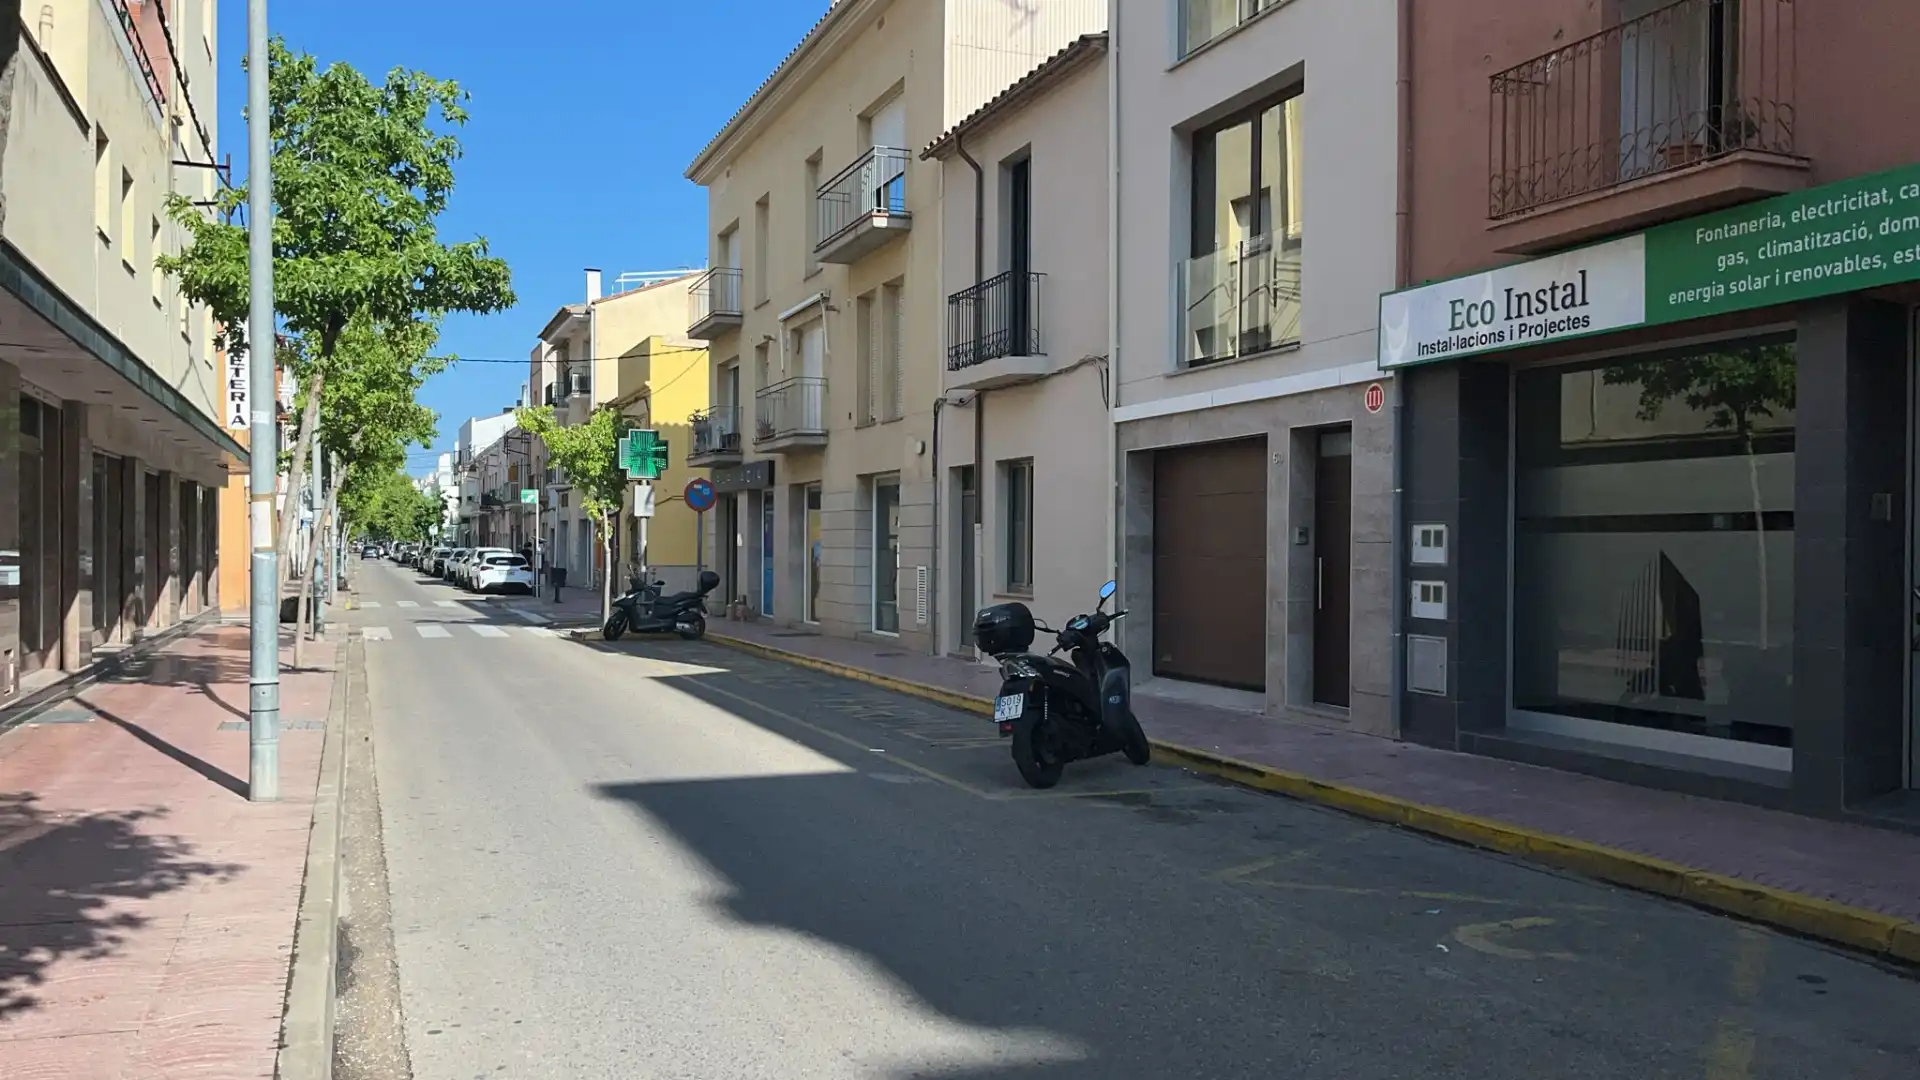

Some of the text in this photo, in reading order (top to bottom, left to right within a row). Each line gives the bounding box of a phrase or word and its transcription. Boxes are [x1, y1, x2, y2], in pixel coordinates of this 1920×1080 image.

[1696, 211, 1786, 244] Fontaneria,
[1791, 187, 1893, 222] electricitat,
[1717, 215, 1919, 272] gas, climatització, dom
[1448, 270, 1589, 332] Eco Instal
[1668, 279, 1725, 305] energia
[1729, 275, 1770, 295] solar
[1774, 268, 1780, 286] i
[1784, 254, 1887, 285] renovables,
[1417, 313, 1591, 357] Instal·lacions i Projectes
[230, 354, 246, 425] ETERIA
